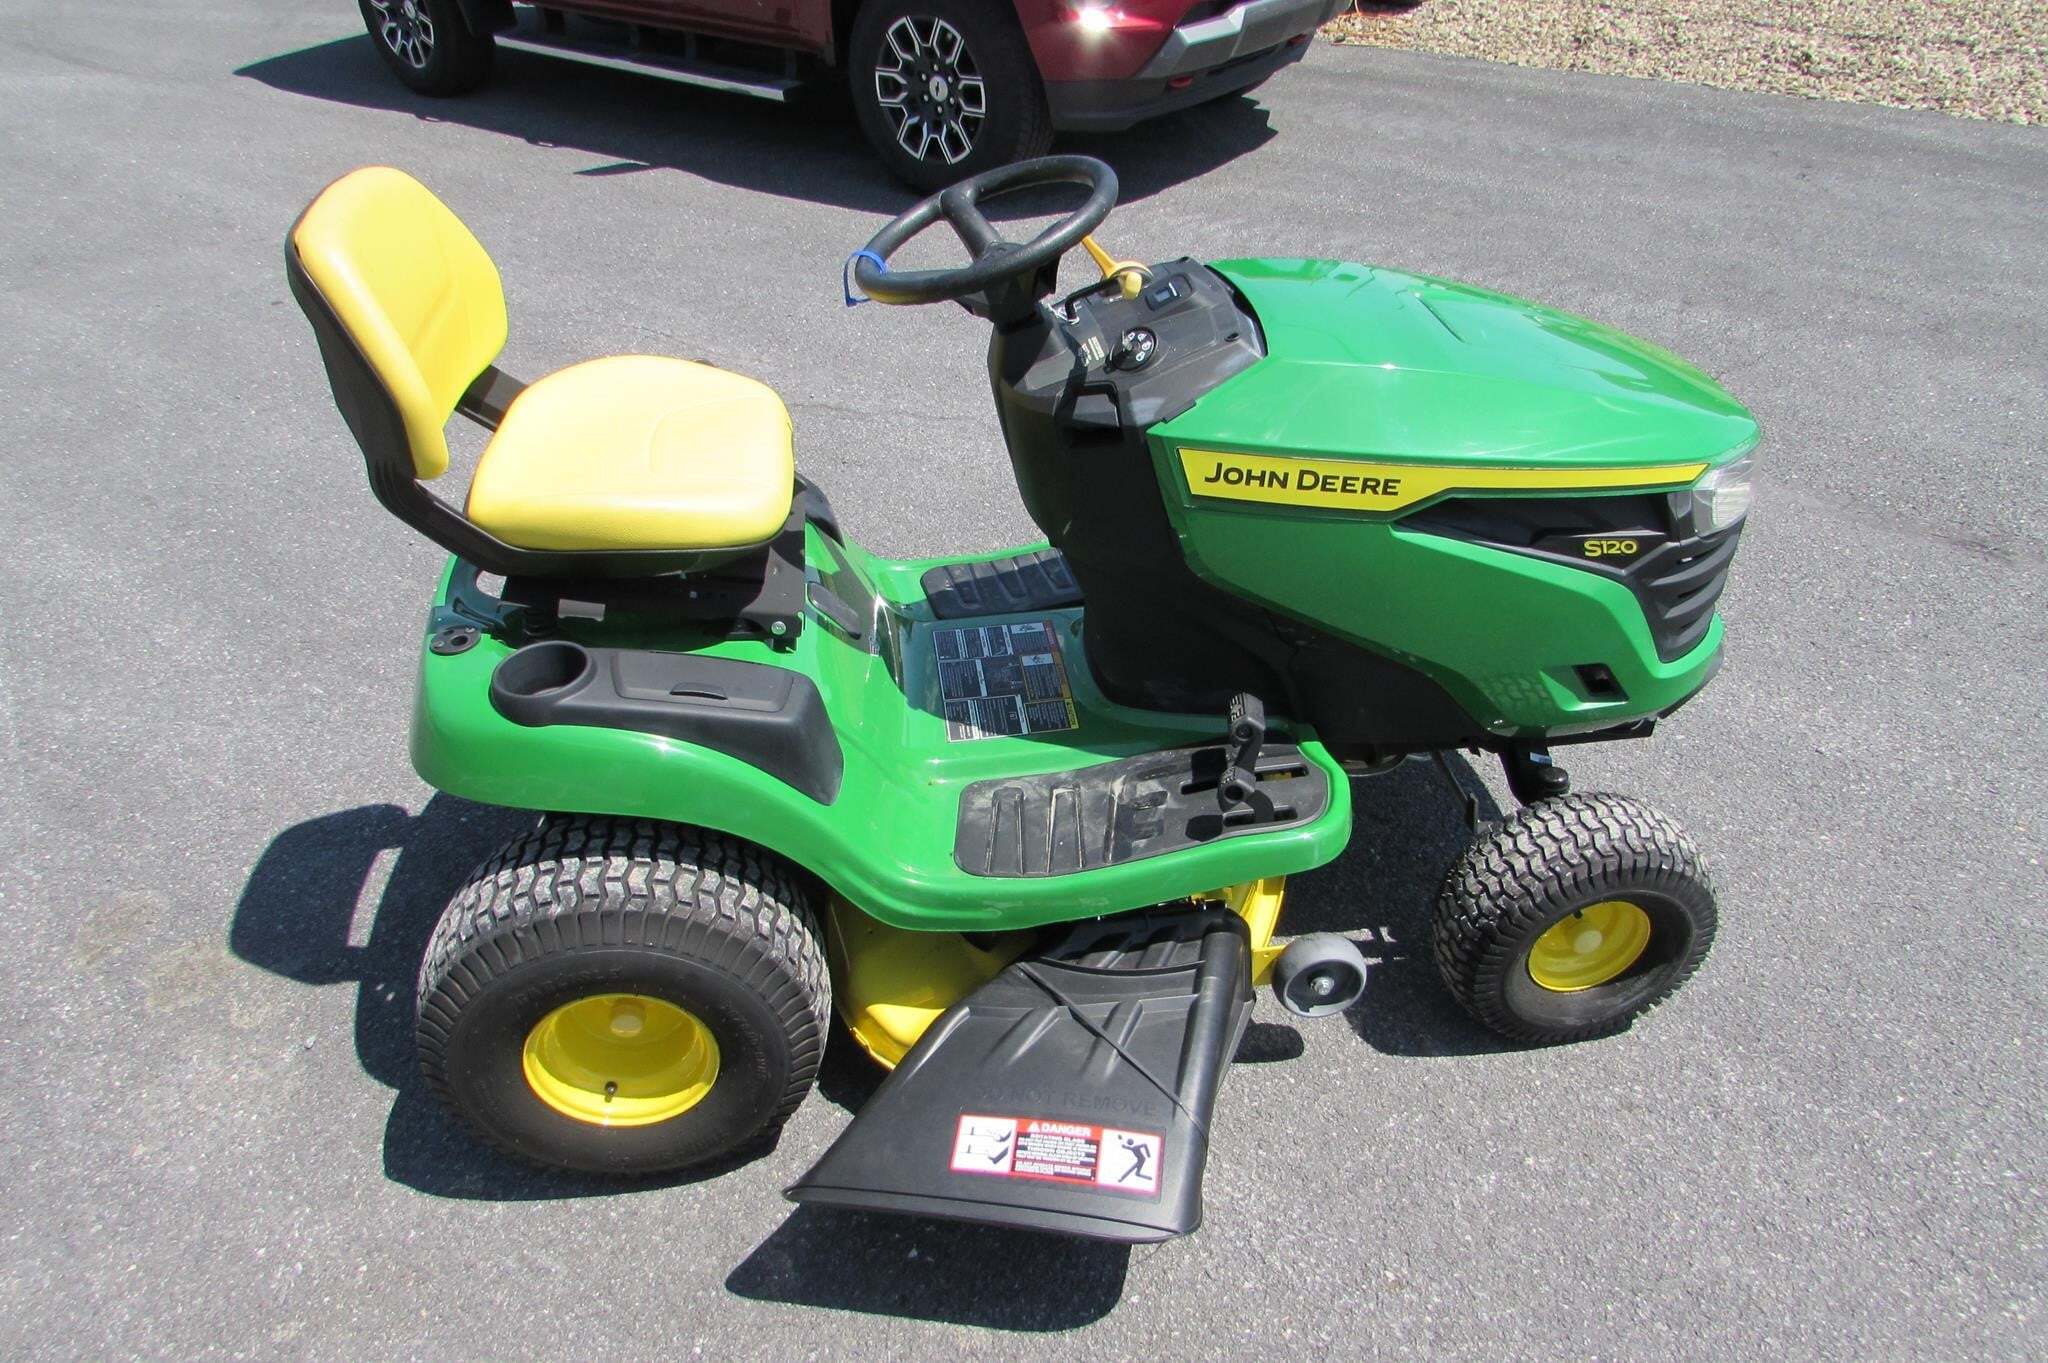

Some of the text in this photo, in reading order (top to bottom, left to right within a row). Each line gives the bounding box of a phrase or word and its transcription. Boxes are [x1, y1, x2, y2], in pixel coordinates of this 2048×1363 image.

[1204, 462, 1401, 496] JOHN DEERE
[1584, 540, 1637, 557] S120
[1062, 1091, 1156, 1115] REMOVE
[1042, 1123, 1091, 1136] DANGER
